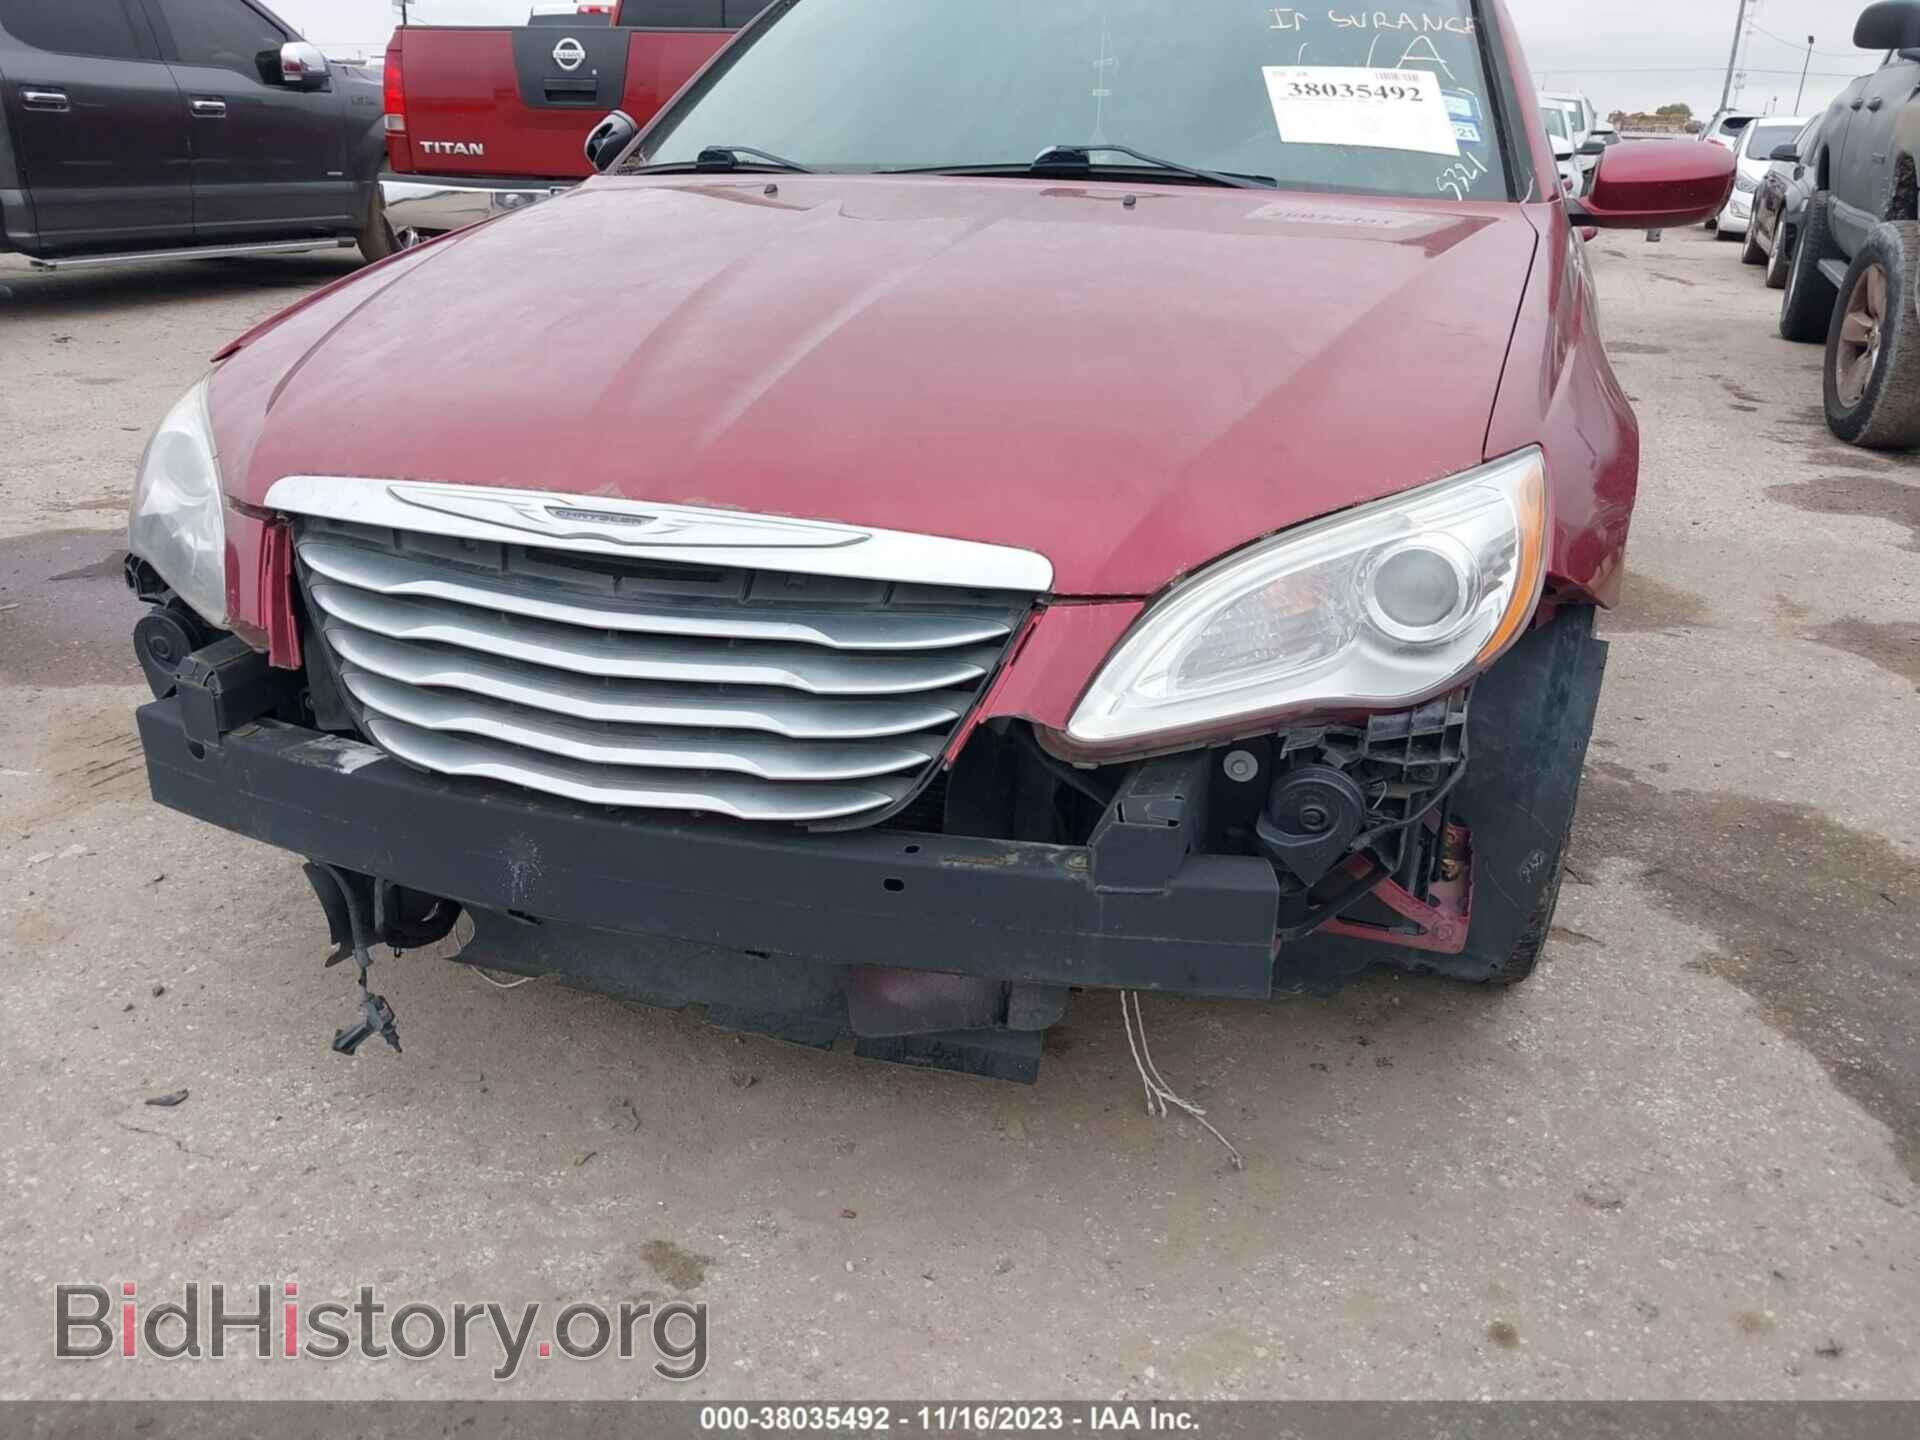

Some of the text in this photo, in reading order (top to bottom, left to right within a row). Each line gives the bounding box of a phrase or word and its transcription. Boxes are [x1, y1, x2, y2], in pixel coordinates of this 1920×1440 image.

[1287, 82, 1423, 102] 38035492
[1456, 127, 1476, 138] 21
[419, 140, 484, 156] TITAN
